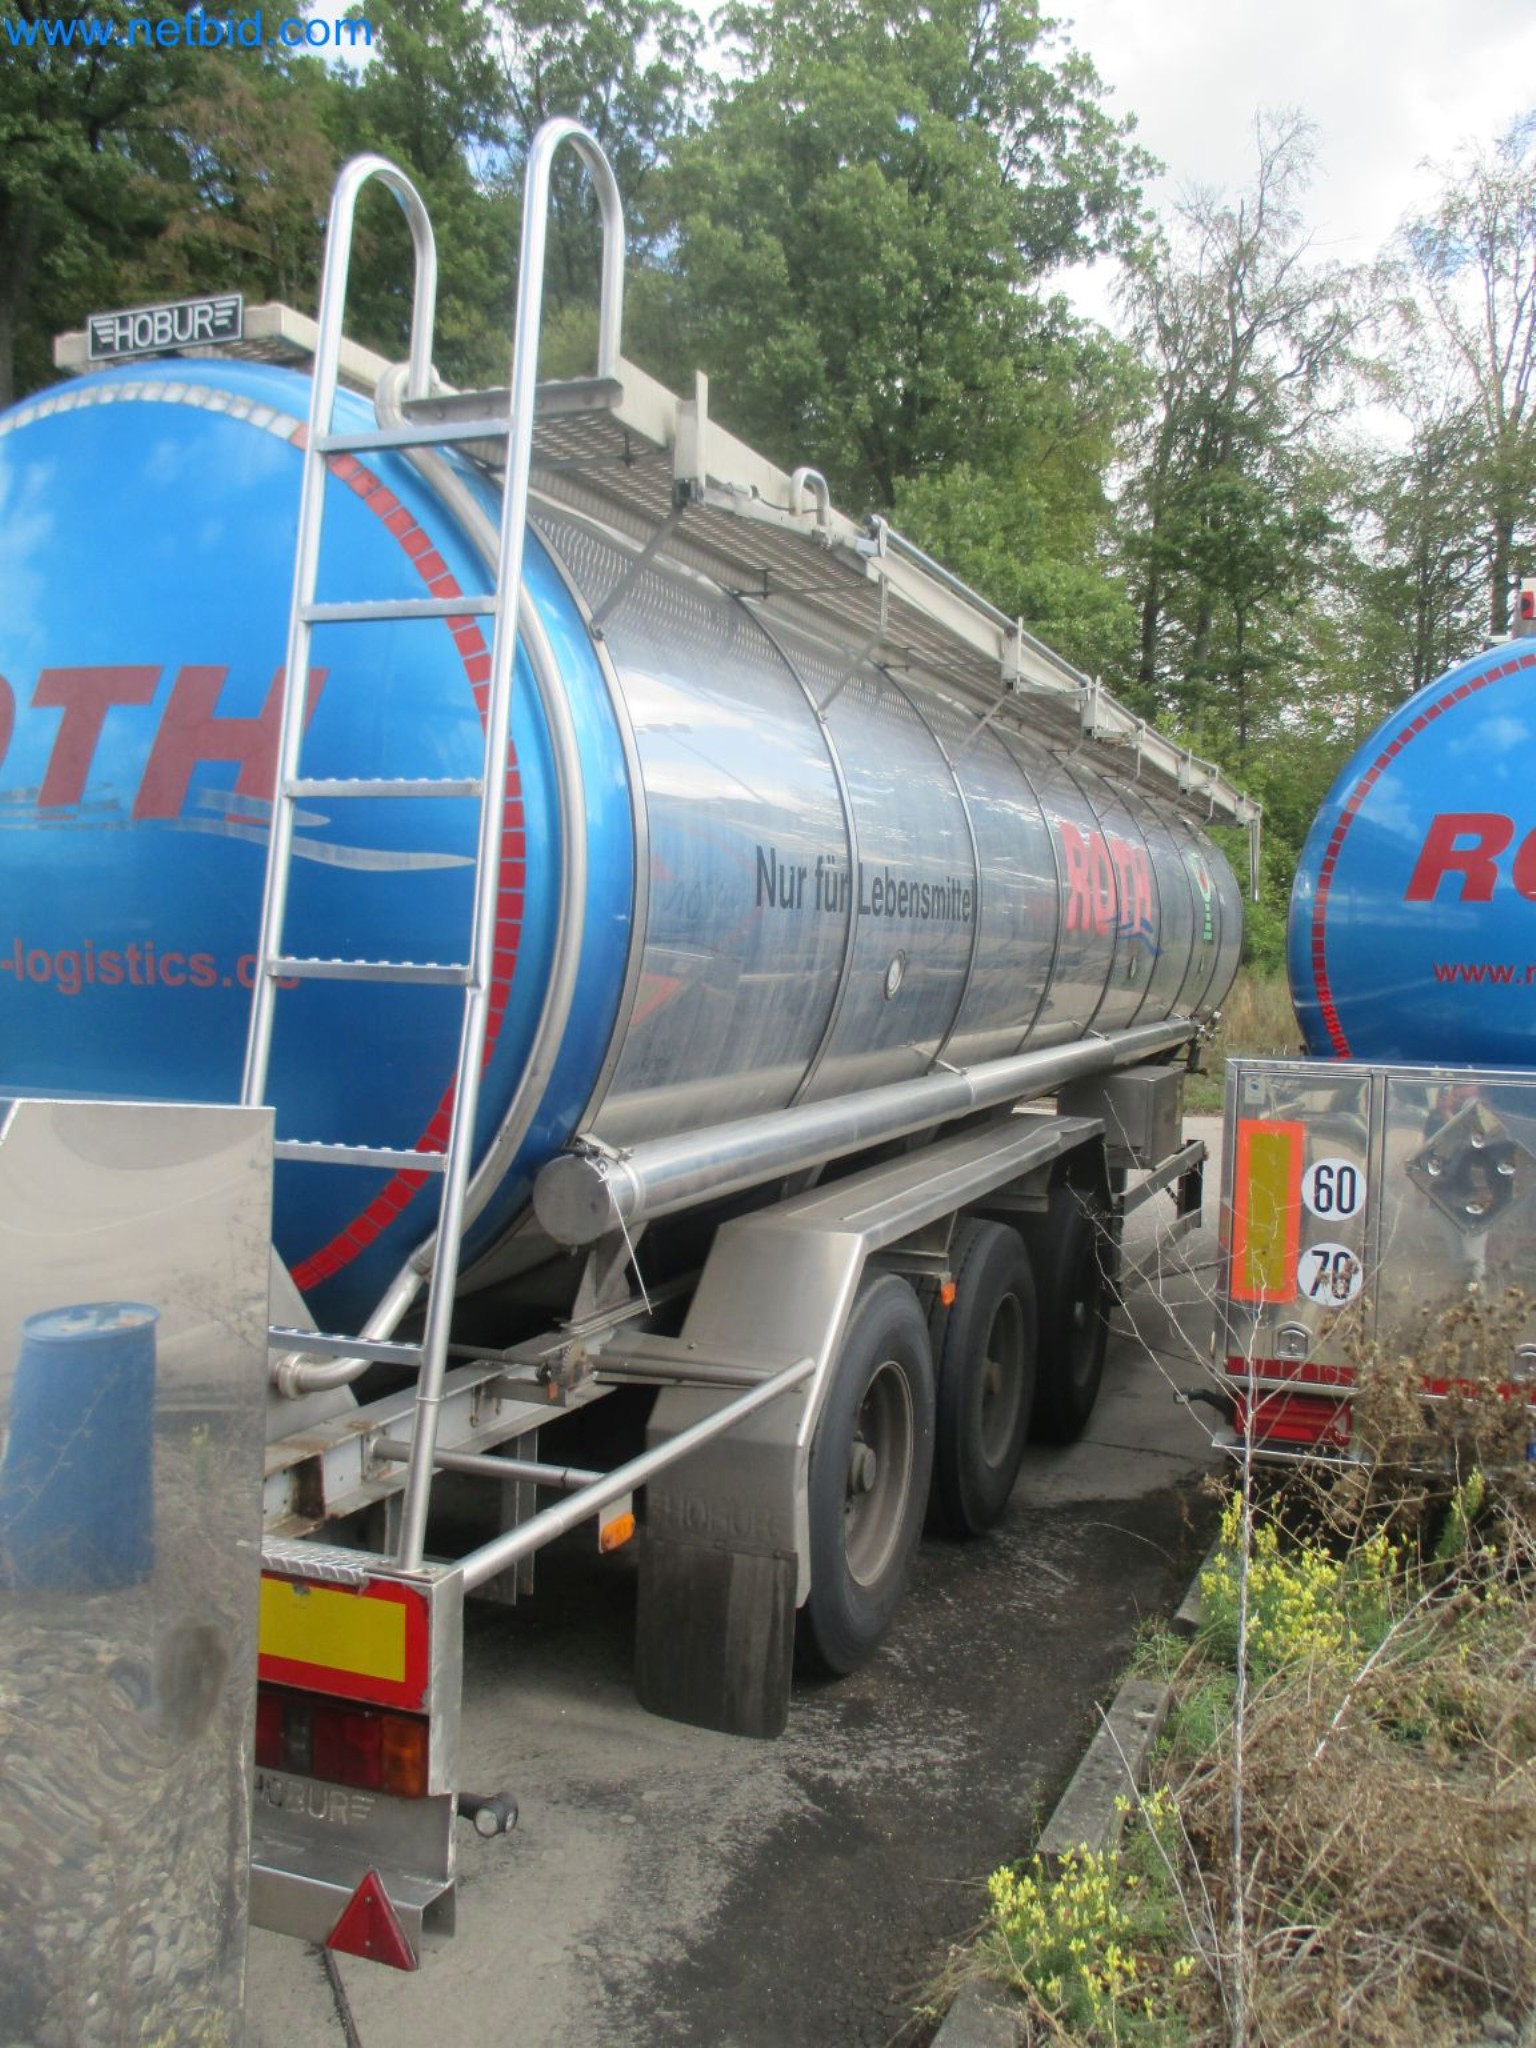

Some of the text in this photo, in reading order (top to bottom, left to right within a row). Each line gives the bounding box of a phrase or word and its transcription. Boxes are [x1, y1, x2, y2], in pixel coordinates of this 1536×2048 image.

[115, 304, 214, 352] HOBUR
[0, 664, 330, 825] TH
[756, 844, 978, 923] Nur für Lebensmittel
[1058, 820, 1153, 937] ROTH
[1, 938, 300, 995] -logistics.c
[1314, 1164, 1357, 1214] 60
[1309, 1250, 1352, 1300] 70
